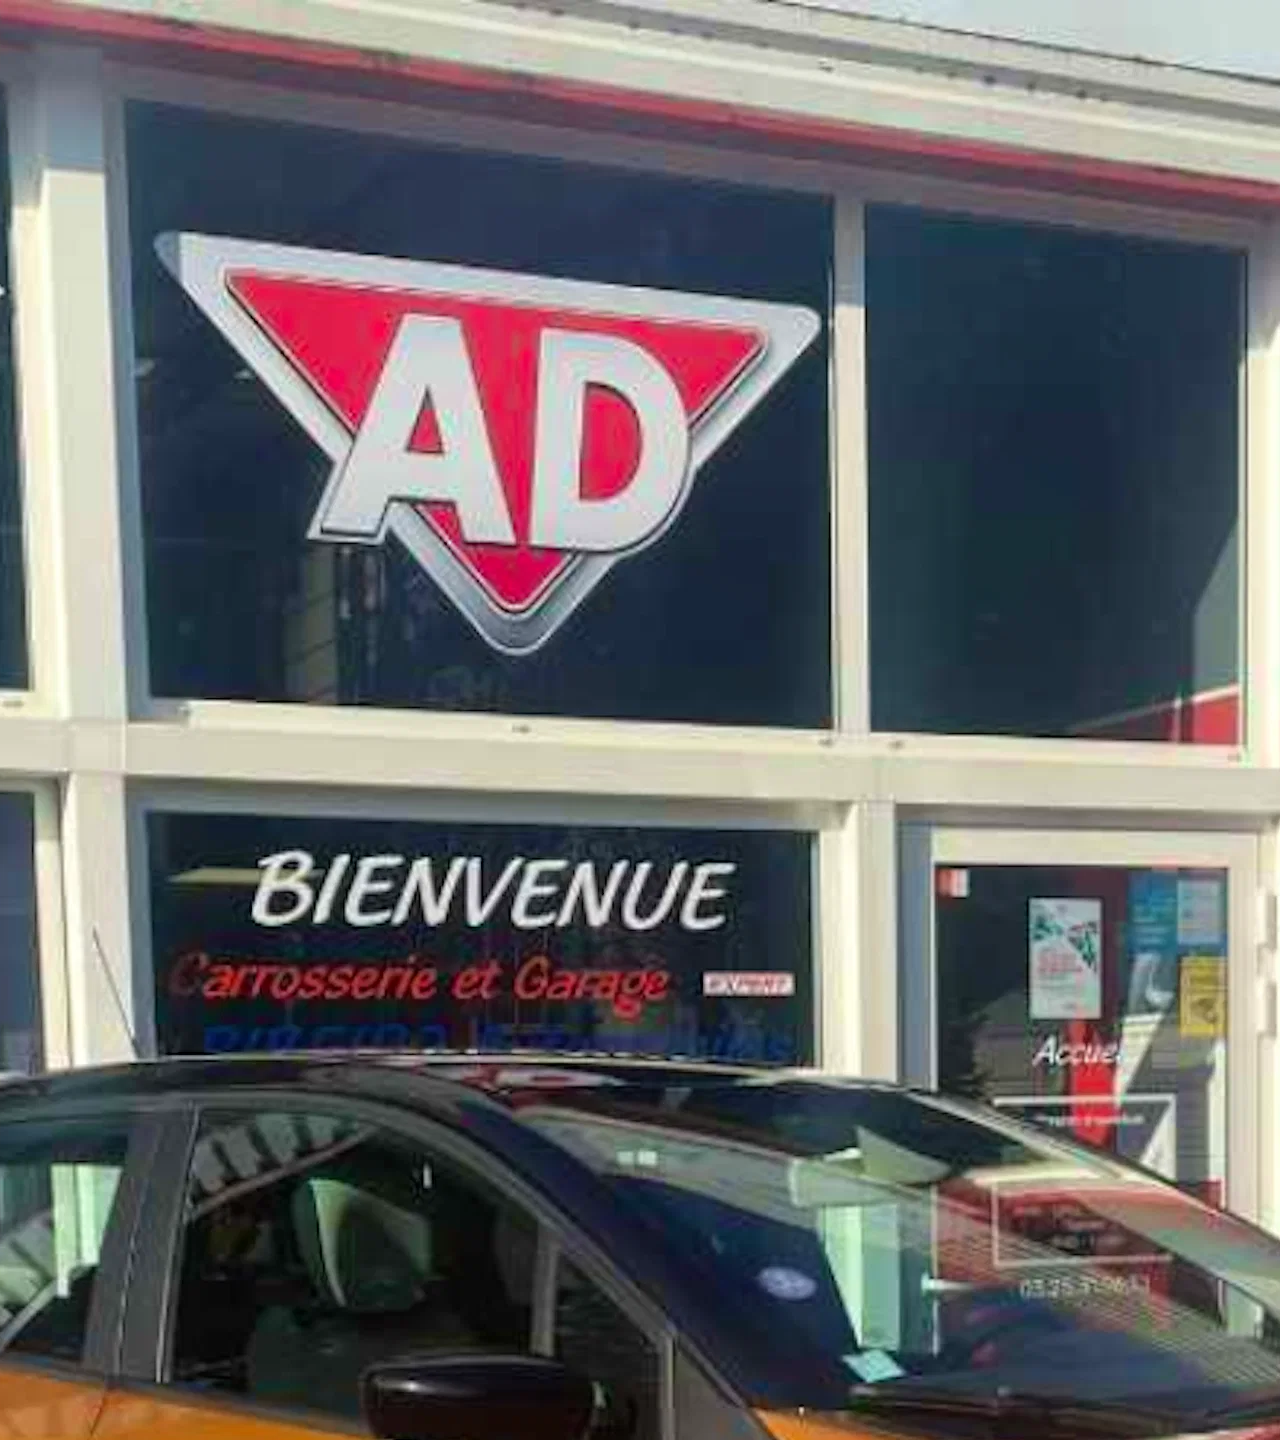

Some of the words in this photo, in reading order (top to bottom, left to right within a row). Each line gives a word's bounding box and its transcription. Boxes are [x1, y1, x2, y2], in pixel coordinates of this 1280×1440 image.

[320, 313, 692, 553] AD
[252, 850, 737, 931] BIENVENUE
[169, 951, 438, 1001] Carrosserie
[452, 960, 503, 1000] et
[513, 953, 671, 1019] Garage
